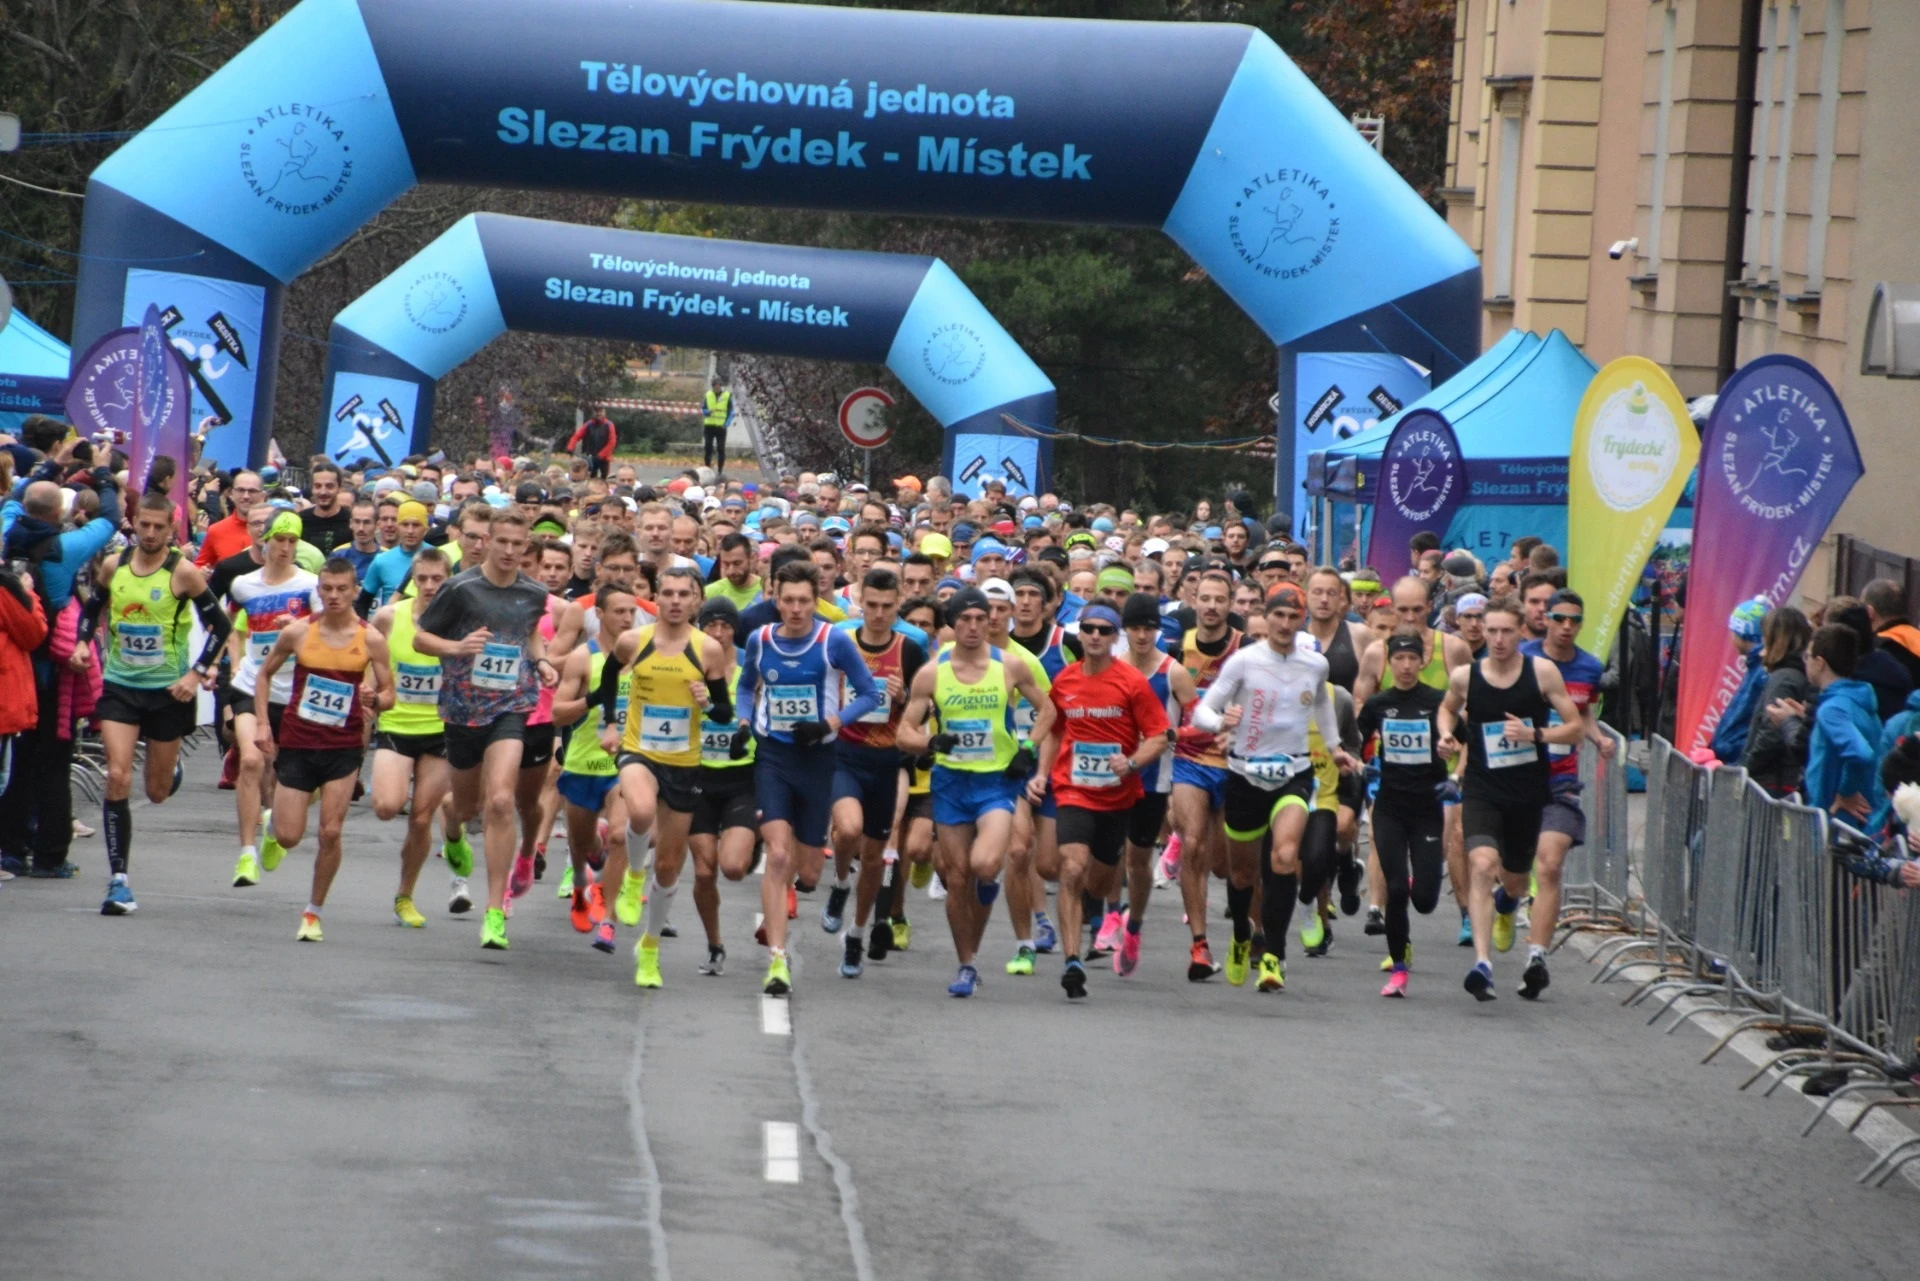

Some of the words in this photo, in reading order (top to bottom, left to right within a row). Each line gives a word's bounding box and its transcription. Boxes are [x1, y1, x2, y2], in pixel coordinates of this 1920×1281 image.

[580, 60, 853, 110] Tělovýchovná
[864, 81, 1015, 119] jednota
[256, 102, 345, 142] ATLETIKA
[496, 106, 670, 156] Slezan
[689, 120, 868, 171] Frýdek
[882, 152, 900, 163] -
[916, 134, 1094, 181] Místek
[239, 142, 265, 197] SLEZAN
[1243, 168, 1330, 200] ATLETIKA
[1228, 215, 1255, 265] SLEZAN
[590, 252, 728, 284] Tělovýchovná
[731, 267, 811, 290] jednota
[415, 271, 463, 293] ATLETIKA
[545, 277, 634, 308] Slezan
[642, 288, 734, 318] Frýdek
[757, 299, 849, 328] Místek
[213, 319, 240, 355] DESÍTKA
[931, 323, 980, 343] ATLETIKA
[0, 392, 42, 408] ístek
[1375, 392, 1400, 415] DESÍT
[1743, 384, 1828, 433] ATLETIKA
[1402, 430, 1451, 462] ATLETIKA
[1500, 463, 1569, 477] Tělovýcho
[1722, 431, 1745, 496] SLEZAN
[1389, 462, 1402, 506] SLEZAN
[1471, 480, 1531, 496] Slezan
[124, 636, 157, 651] 142
[480, 657, 516, 674] 417
[401, 675, 435, 690] 371
[970, 686, 999, 694] POLAR
[308, 690, 345, 711] 214
[775, 700, 811, 715] 133
[944, 694, 999, 706] MIZUNO
[1087, 705, 1123, 719] republic
[659, 720, 672, 736] 4
[705, 734, 730, 748] 49
[957, 732, 987, 748] 87
[1388, 734, 1423, 748] 501
[1255, 765, 1289, 778] 114
